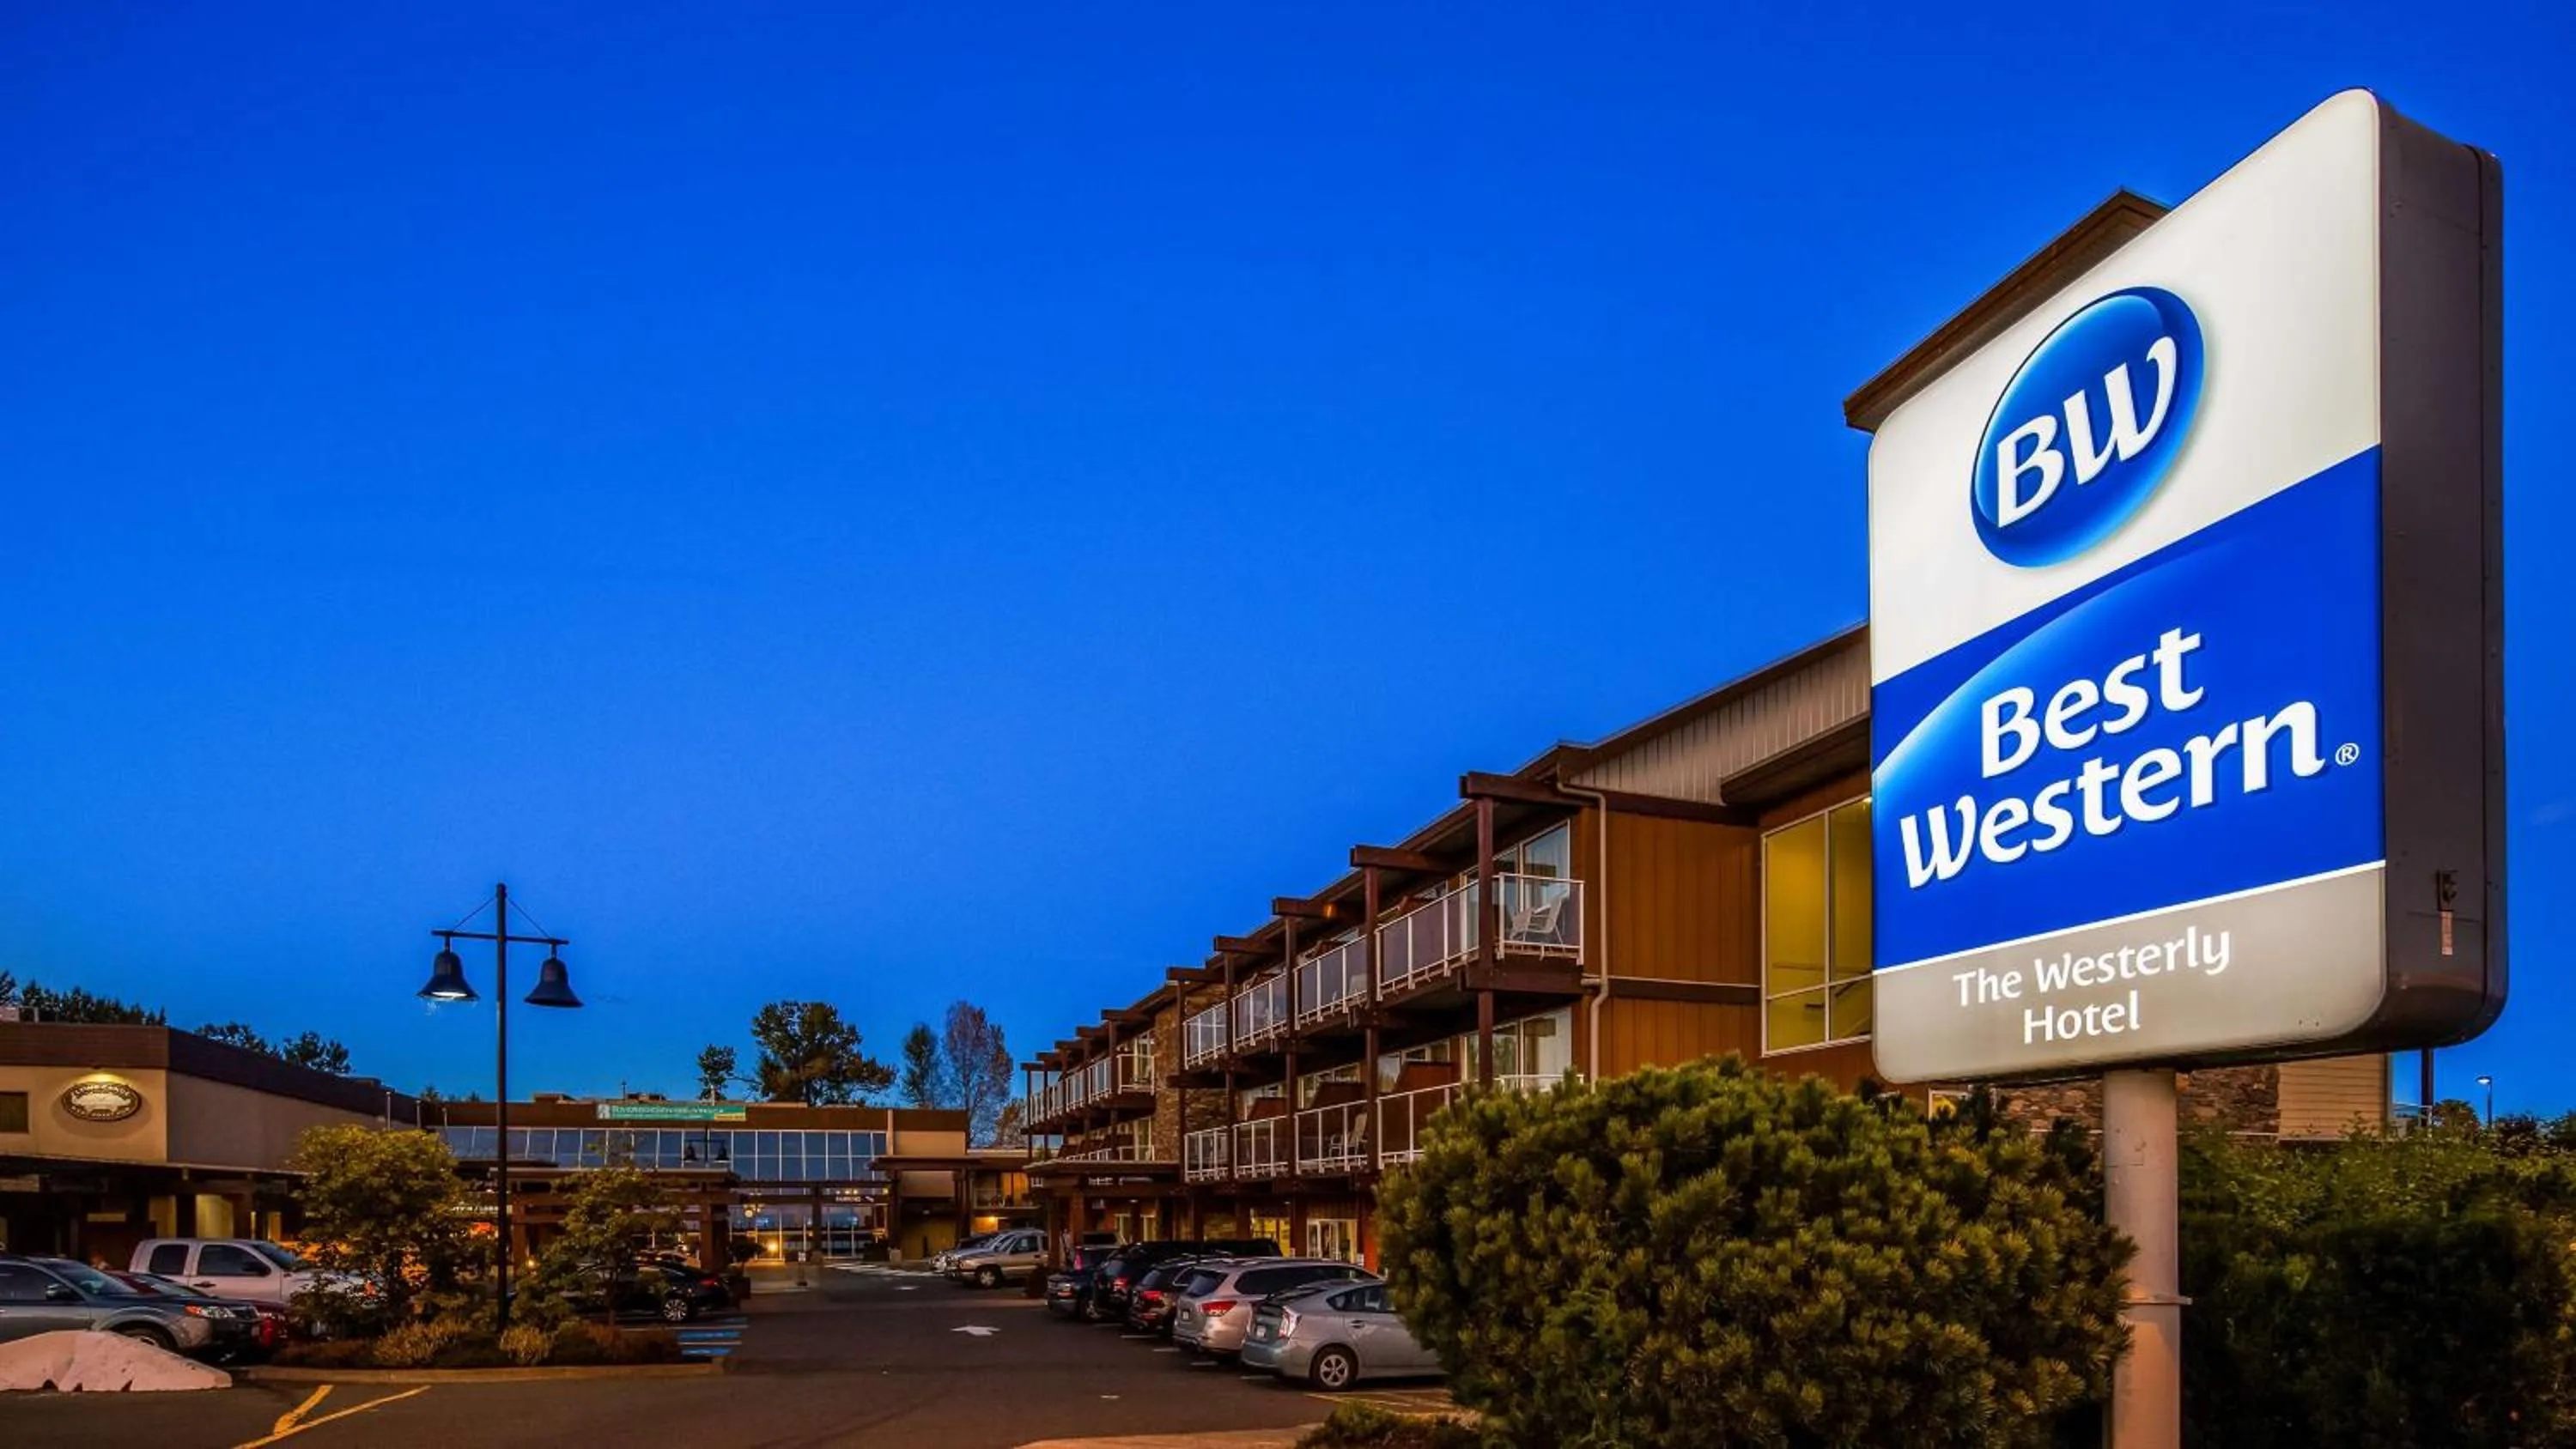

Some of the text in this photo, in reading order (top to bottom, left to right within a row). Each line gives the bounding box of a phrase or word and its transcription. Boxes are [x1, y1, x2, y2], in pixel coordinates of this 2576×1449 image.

[1996, 336, 2178, 529] BW
[1981, 627, 2204, 779] Best
[1899, 700, 2325, 888] Western
[1953, 925, 2231, 1007] The Westerly
[2023, 990, 2141, 1045] Hotel
